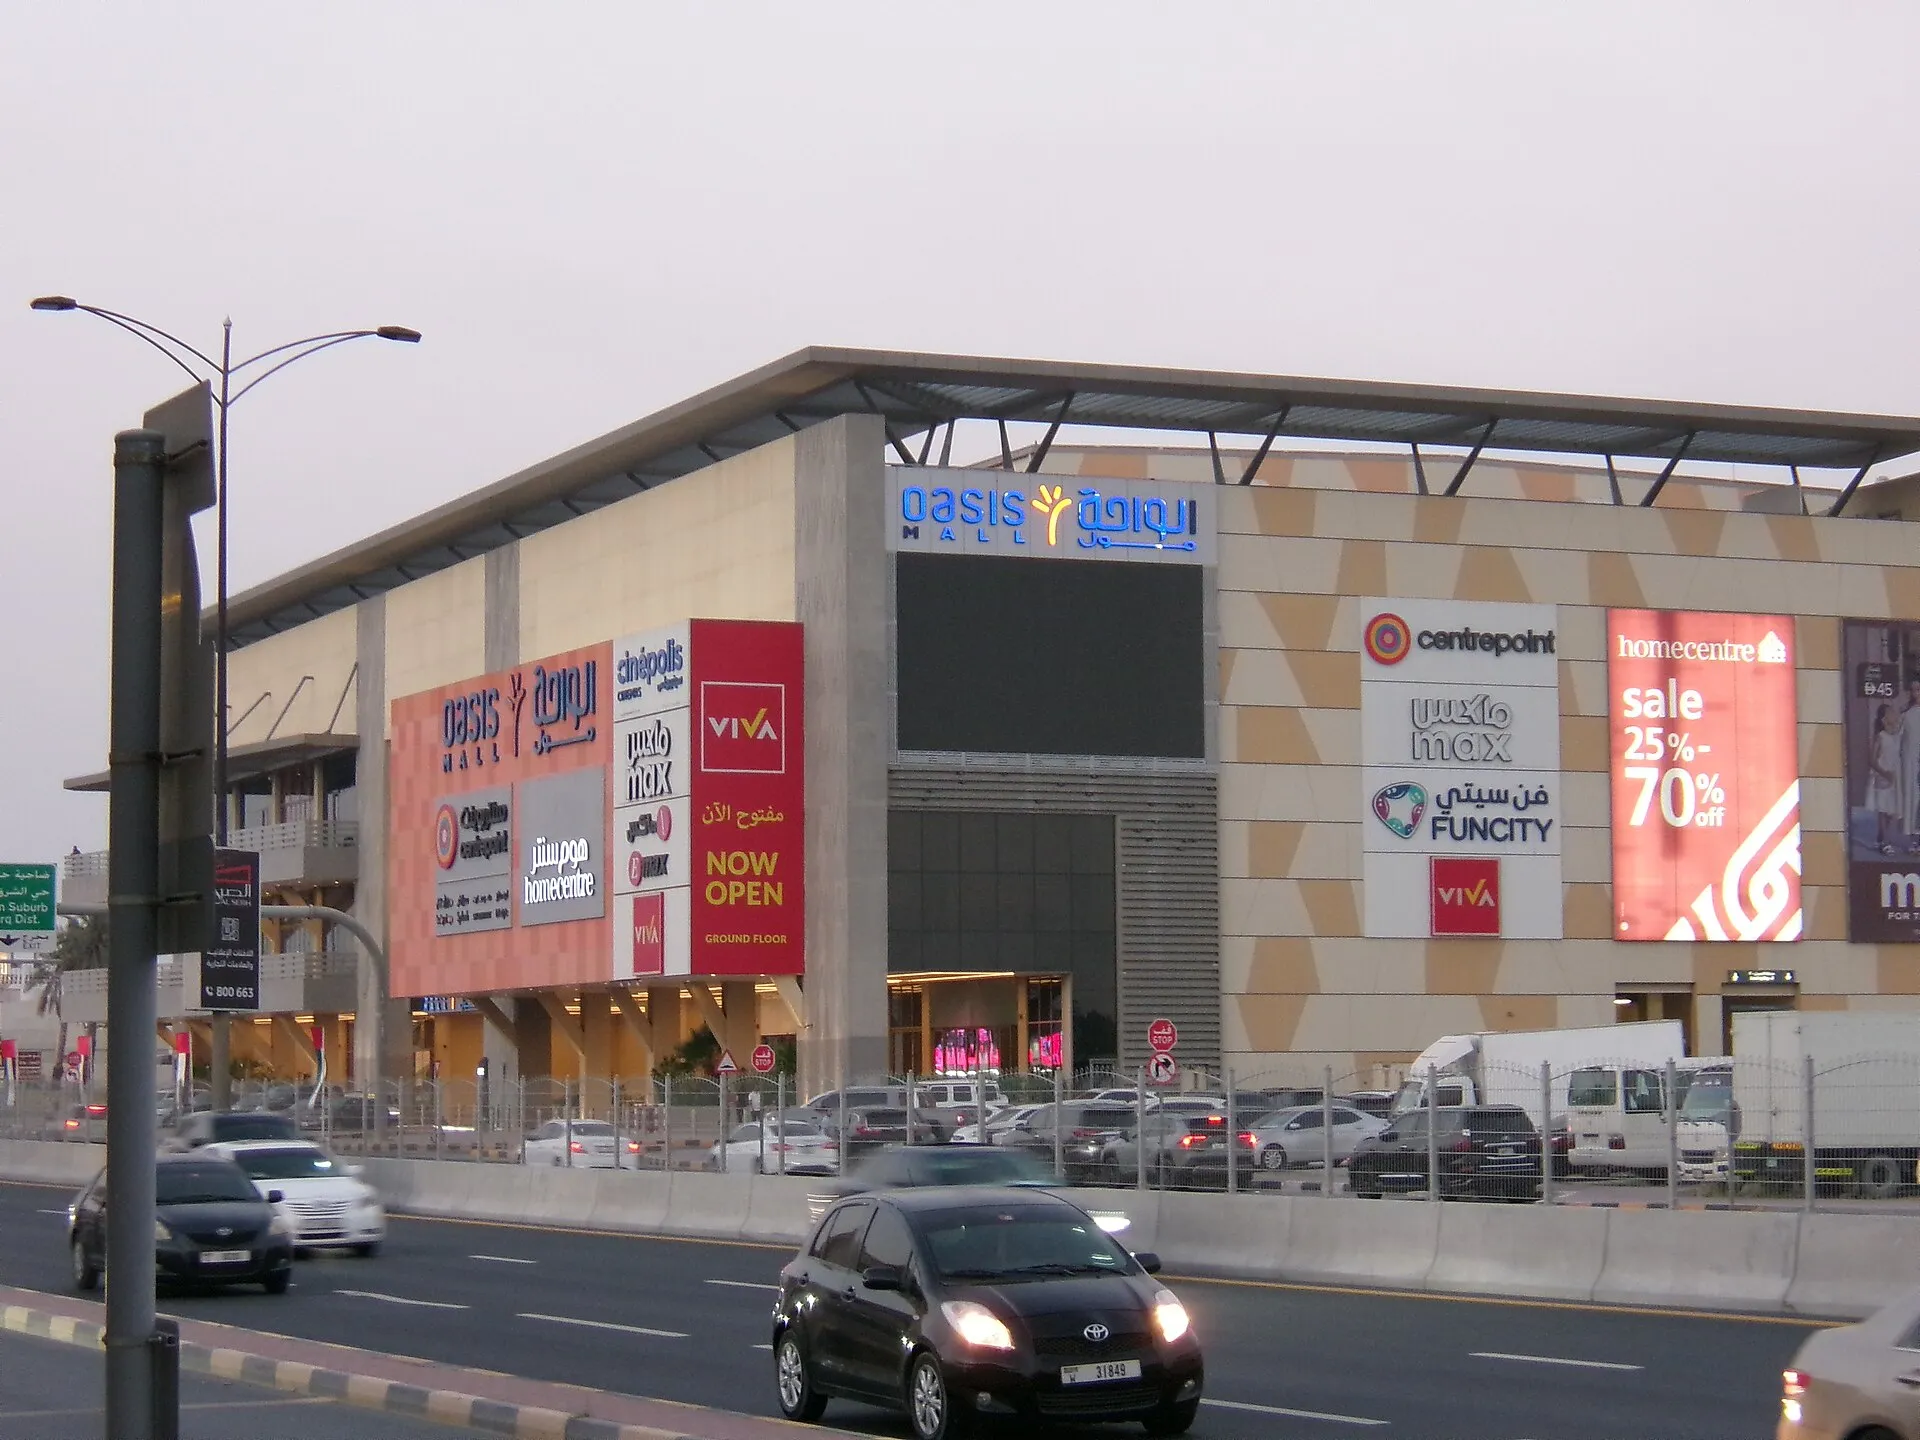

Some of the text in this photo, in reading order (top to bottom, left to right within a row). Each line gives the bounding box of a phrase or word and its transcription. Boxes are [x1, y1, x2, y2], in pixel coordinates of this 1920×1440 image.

[902, 525, 1026, 544] MALL
[1417, 627, 1556, 657] centrepoint
[1617, 635, 1756, 662] homecentre
[1622, 677, 1703, 720] sale
[708, 707, 778, 740] VIVA
[443, 743, 500, 773] MALL
[1411, 731, 1513, 762] max
[626, 761, 673, 801] max
[1436, 782, 1549, 815] فن سيتي
[702, 801, 784, 830] مفتوح الآن
[1694, 806, 1726, 827] off
[1431, 816, 1554, 842] FUNCITY
[707, 851, 779, 876] NOW
[524, 868, 595, 904] homecentre
[705, 880, 783, 906] OPEN
[1437, 878, 1496, 908] VIVA
[8, 901, 49, 912] Suburb
[15, 912, 40, 924] Dist.
[1888, 911, 1910, 920] FOR
[634, 914, 660, 945] VIVA
[705, 933, 787, 944] GROUND FLOOR
[216, 986, 254, 998] 800 663
[1153, 1035, 1172, 1044] STOP
[755, 1058, 771, 1066] STOP
[1096, 1363, 1126, 1379] 31849
